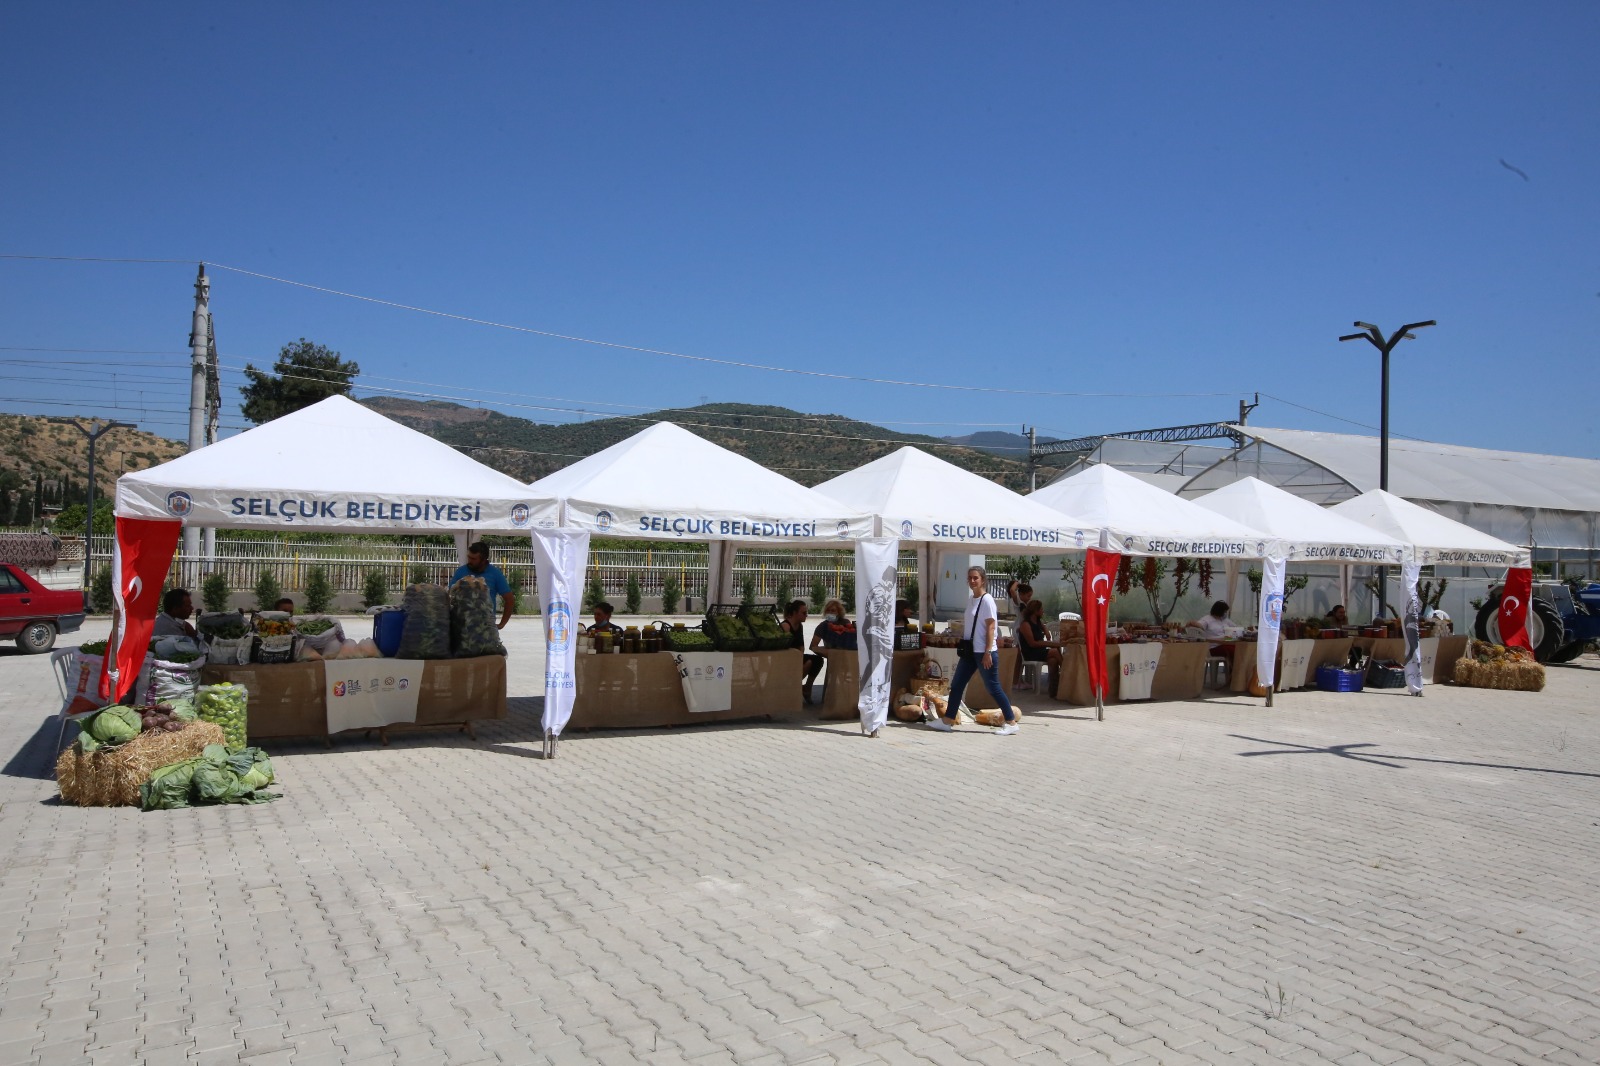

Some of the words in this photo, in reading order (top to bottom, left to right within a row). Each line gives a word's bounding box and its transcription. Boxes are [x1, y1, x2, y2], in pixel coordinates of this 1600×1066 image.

[231, 497, 337, 522] SELÇUK
[346, 499, 481, 522] BELEDİYESİ
[639, 516, 714, 537] SELÇUK
[720, 519, 816, 537] BELEDİYESİ
[932, 524, 986, 542] SELÇUK
[990, 526, 1060, 543] BELEDİYESİ
[1147, 540, 1190, 555] SELÇUK
[1191, 540, 1245, 554] BELEDİYESİ
[1305, 546, 1339, 559] SELÇUK
[1339, 546, 1385, 560] BELEDİYESİ
[1438, 551, 1467, 563] SELÇUK
[545, 671, 570, 679] ELÇUK
